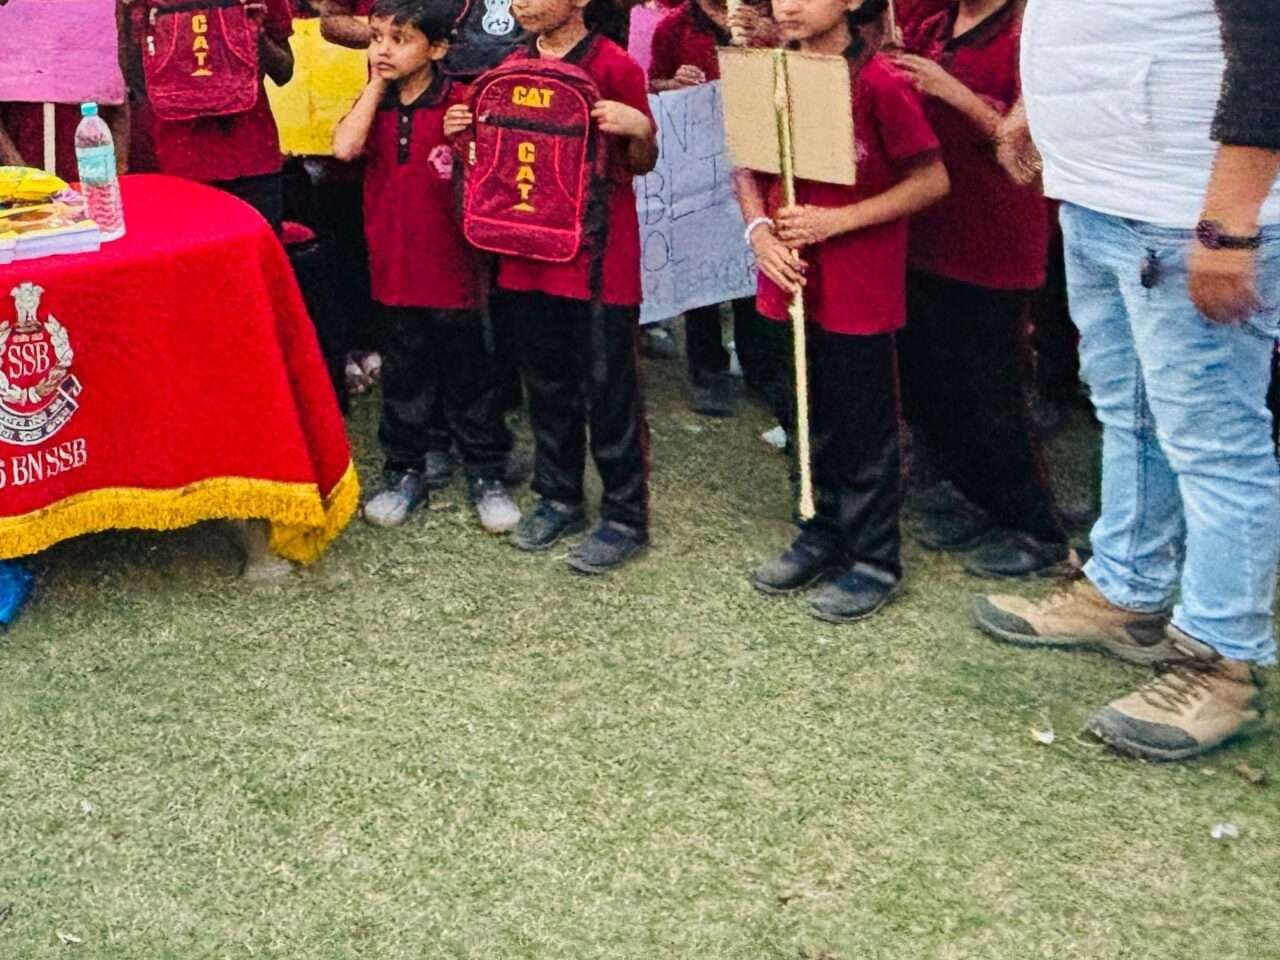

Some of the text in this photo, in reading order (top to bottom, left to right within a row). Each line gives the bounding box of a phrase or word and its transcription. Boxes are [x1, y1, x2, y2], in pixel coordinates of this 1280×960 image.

[191, 14, 209, 66] CAT
[511, 85, 555, 109] CAT
[515, 141, 536, 200] CAT
[7, 341, 51, 380] SSB
[11, 450, 43, 487] BN
[45, 437, 88, 477] SSB
